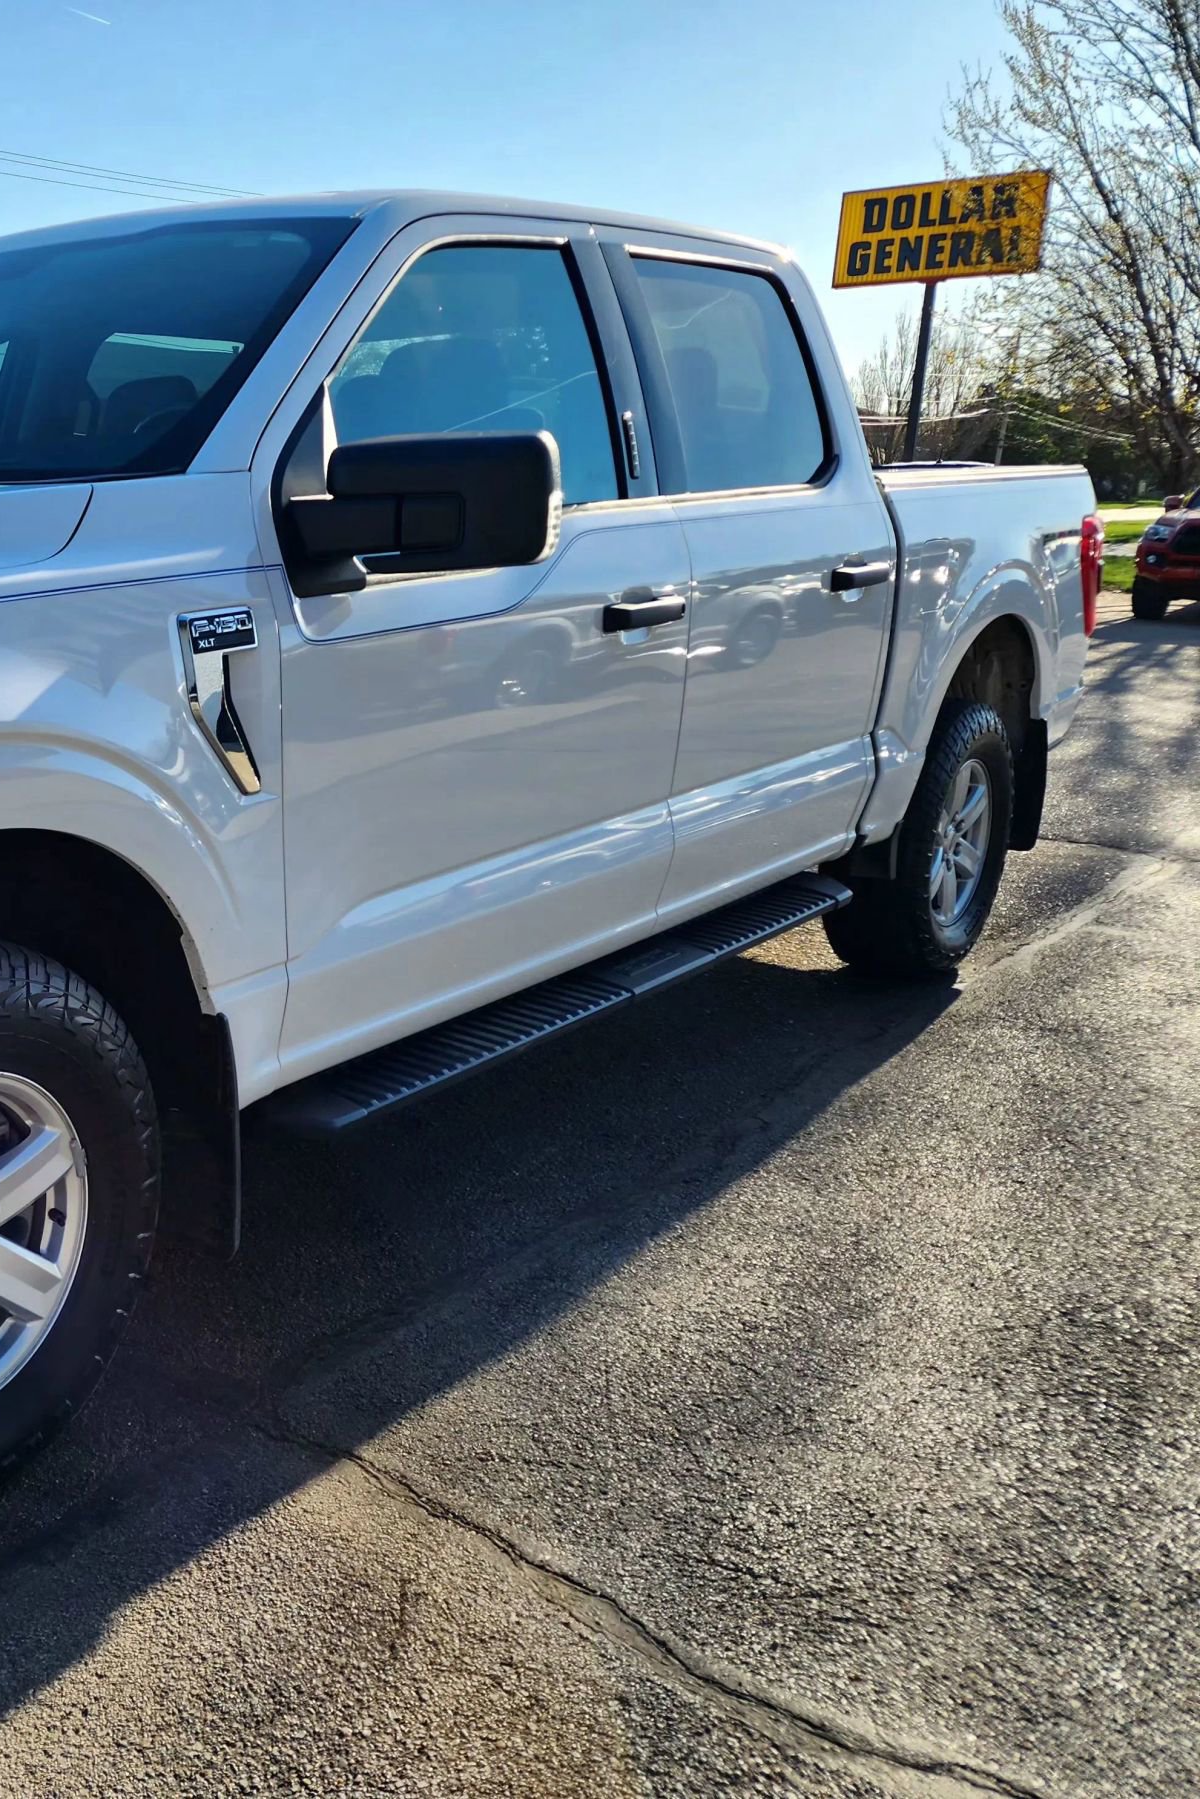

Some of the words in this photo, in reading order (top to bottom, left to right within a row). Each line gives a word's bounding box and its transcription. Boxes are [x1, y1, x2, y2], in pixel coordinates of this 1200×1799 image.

[863, 182, 1020, 234] DOLLAR
[847, 225, 1023, 276] GENERAL
[191, 613, 253, 637] F-150
[198, 638, 216, 648] XLT
